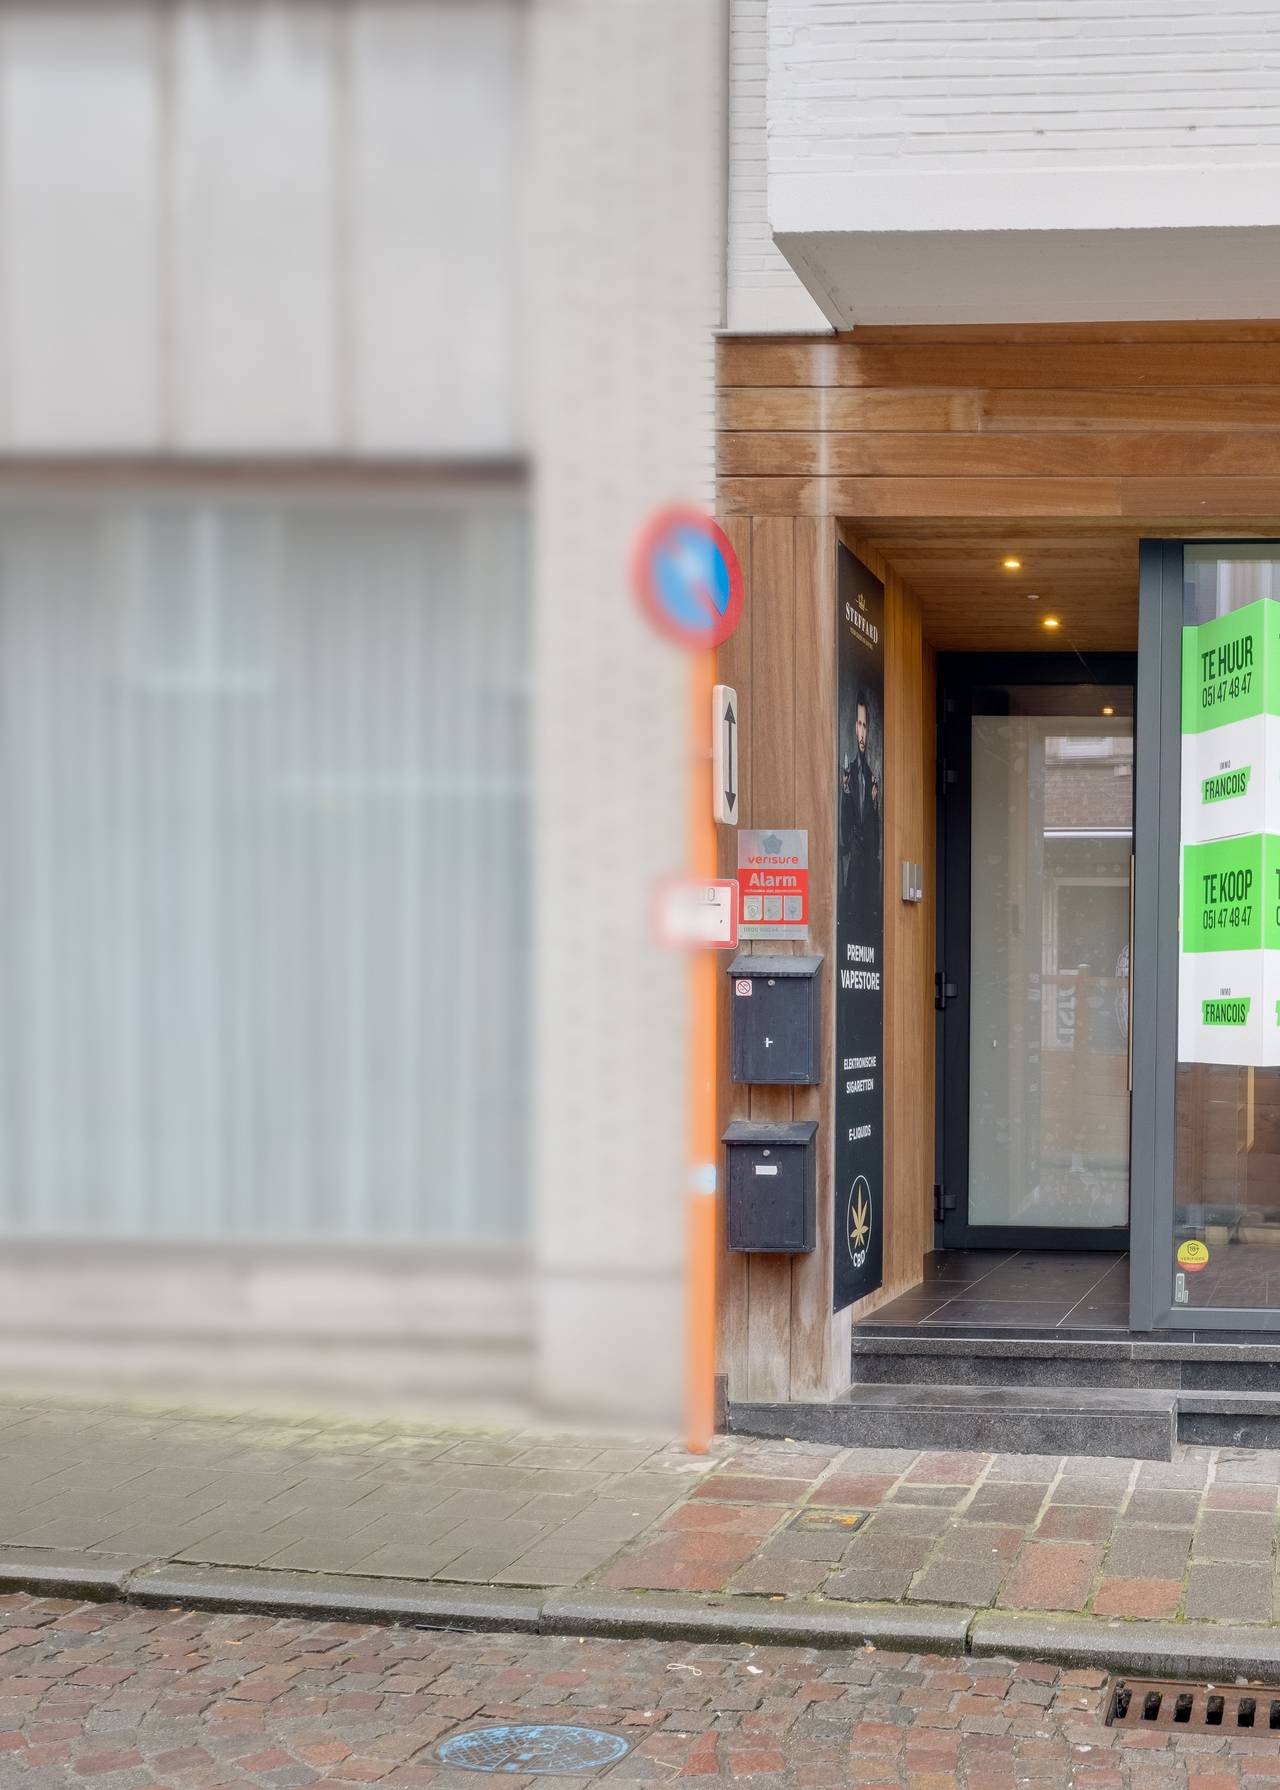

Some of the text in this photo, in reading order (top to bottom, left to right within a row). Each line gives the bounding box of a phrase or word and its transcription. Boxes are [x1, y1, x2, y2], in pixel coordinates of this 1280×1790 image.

[845, 601, 879, 644] STEFFARD
[1201, 635, 1254, 683] TE HUUR
[1202, 671, 1252, 709] 051 47 48 47
[1204, 772, 1246, 801] FRANCOIS
[747, 856, 800, 865] verisure
[749, 872, 797, 887] Alarm
[1203, 869, 1253, 905] TE KOOP
[1203, 906, 1252, 930] 051 47 48 47
[847, 943, 875, 964] PREMIUM
[840, 969, 880, 990] VAPESTORE
[1205, 1004, 1246, 1023] FRANCOIS
[843, 1056, 877, 1071] ELEKTRONISCHE
[846, 1078, 874, 1094] SIGARETTEN
[848, 1124, 871, 1141] E-LIQUIDS
[853, 1249, 866, 1268] CBD
